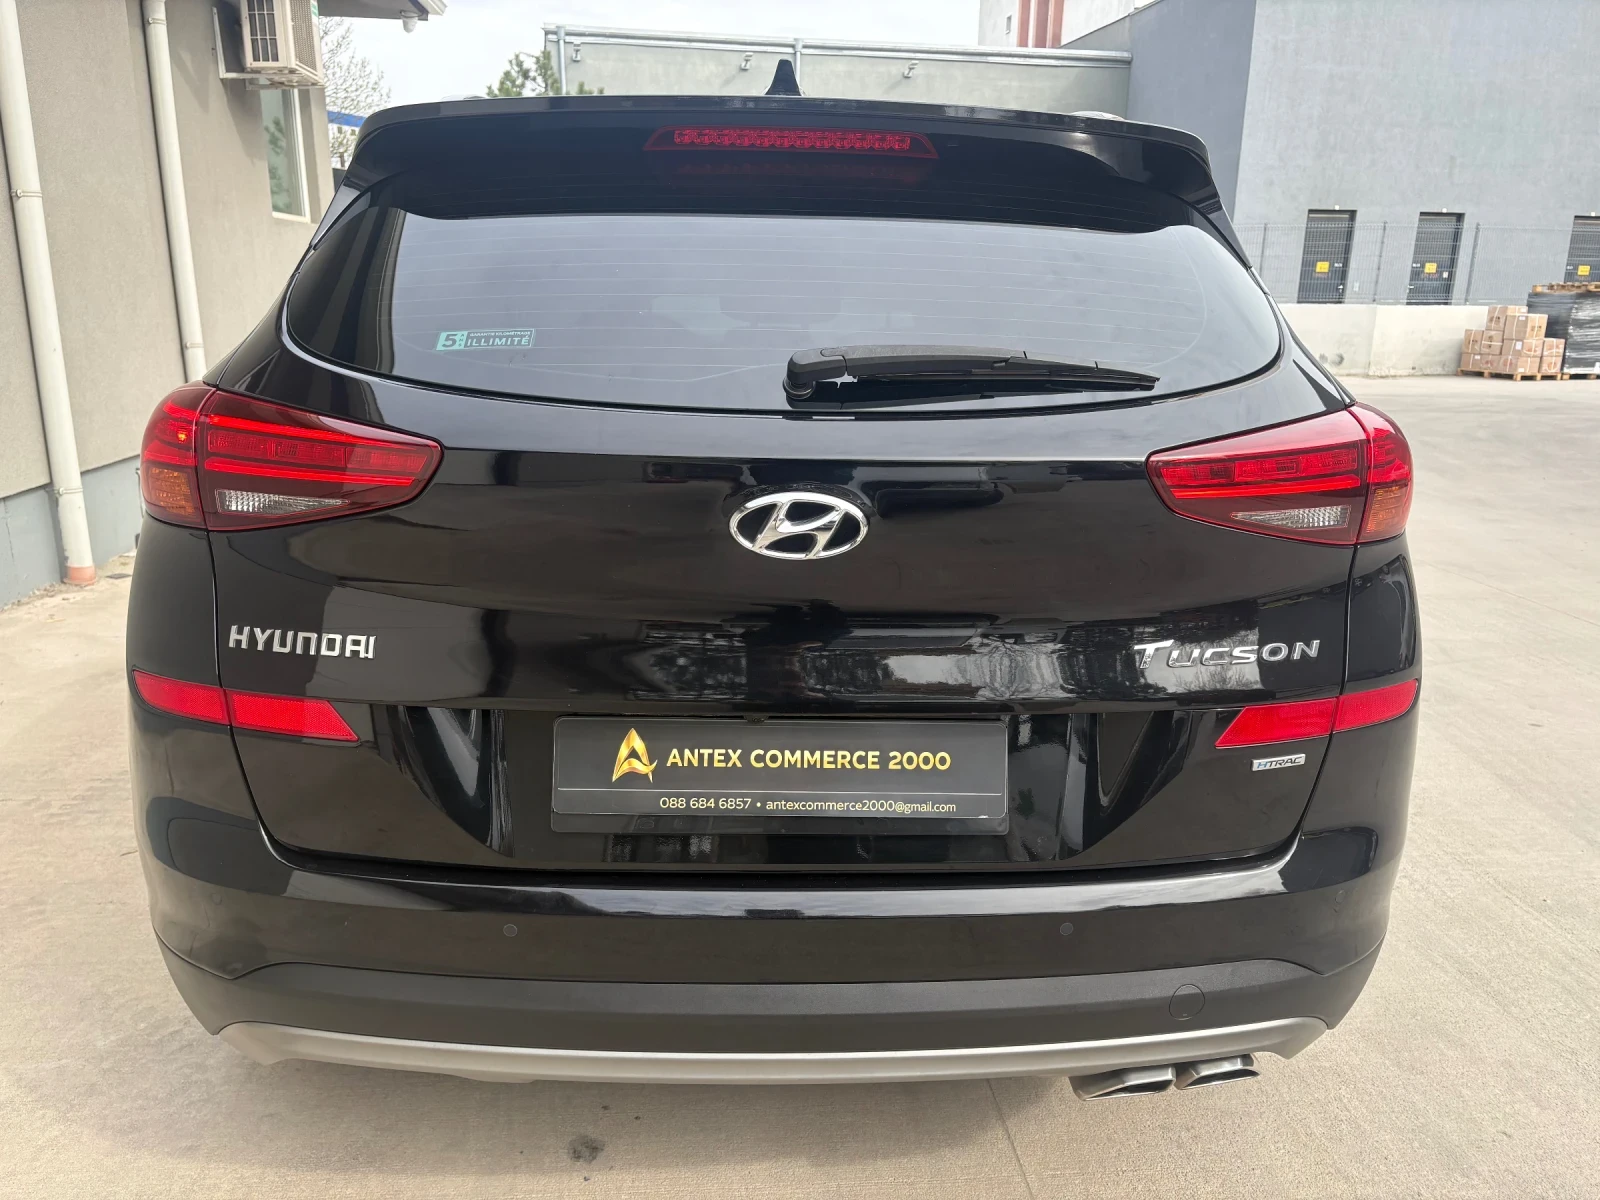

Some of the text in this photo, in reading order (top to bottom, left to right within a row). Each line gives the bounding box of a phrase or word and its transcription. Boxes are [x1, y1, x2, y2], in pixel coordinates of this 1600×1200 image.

[441, 333, 458, 348] 5
[467, 335, 530, 346] ILLIMITÉ
[228, 625, 377, 659] HYUNDAI
[666, 748, 951, 770] ANTEX COMMERCE 2000
[1257, 756, 1303, 769] HTRAC
[659, 797, 957, 814] 088 684 6857 antexcommerce2000@gmail.com
